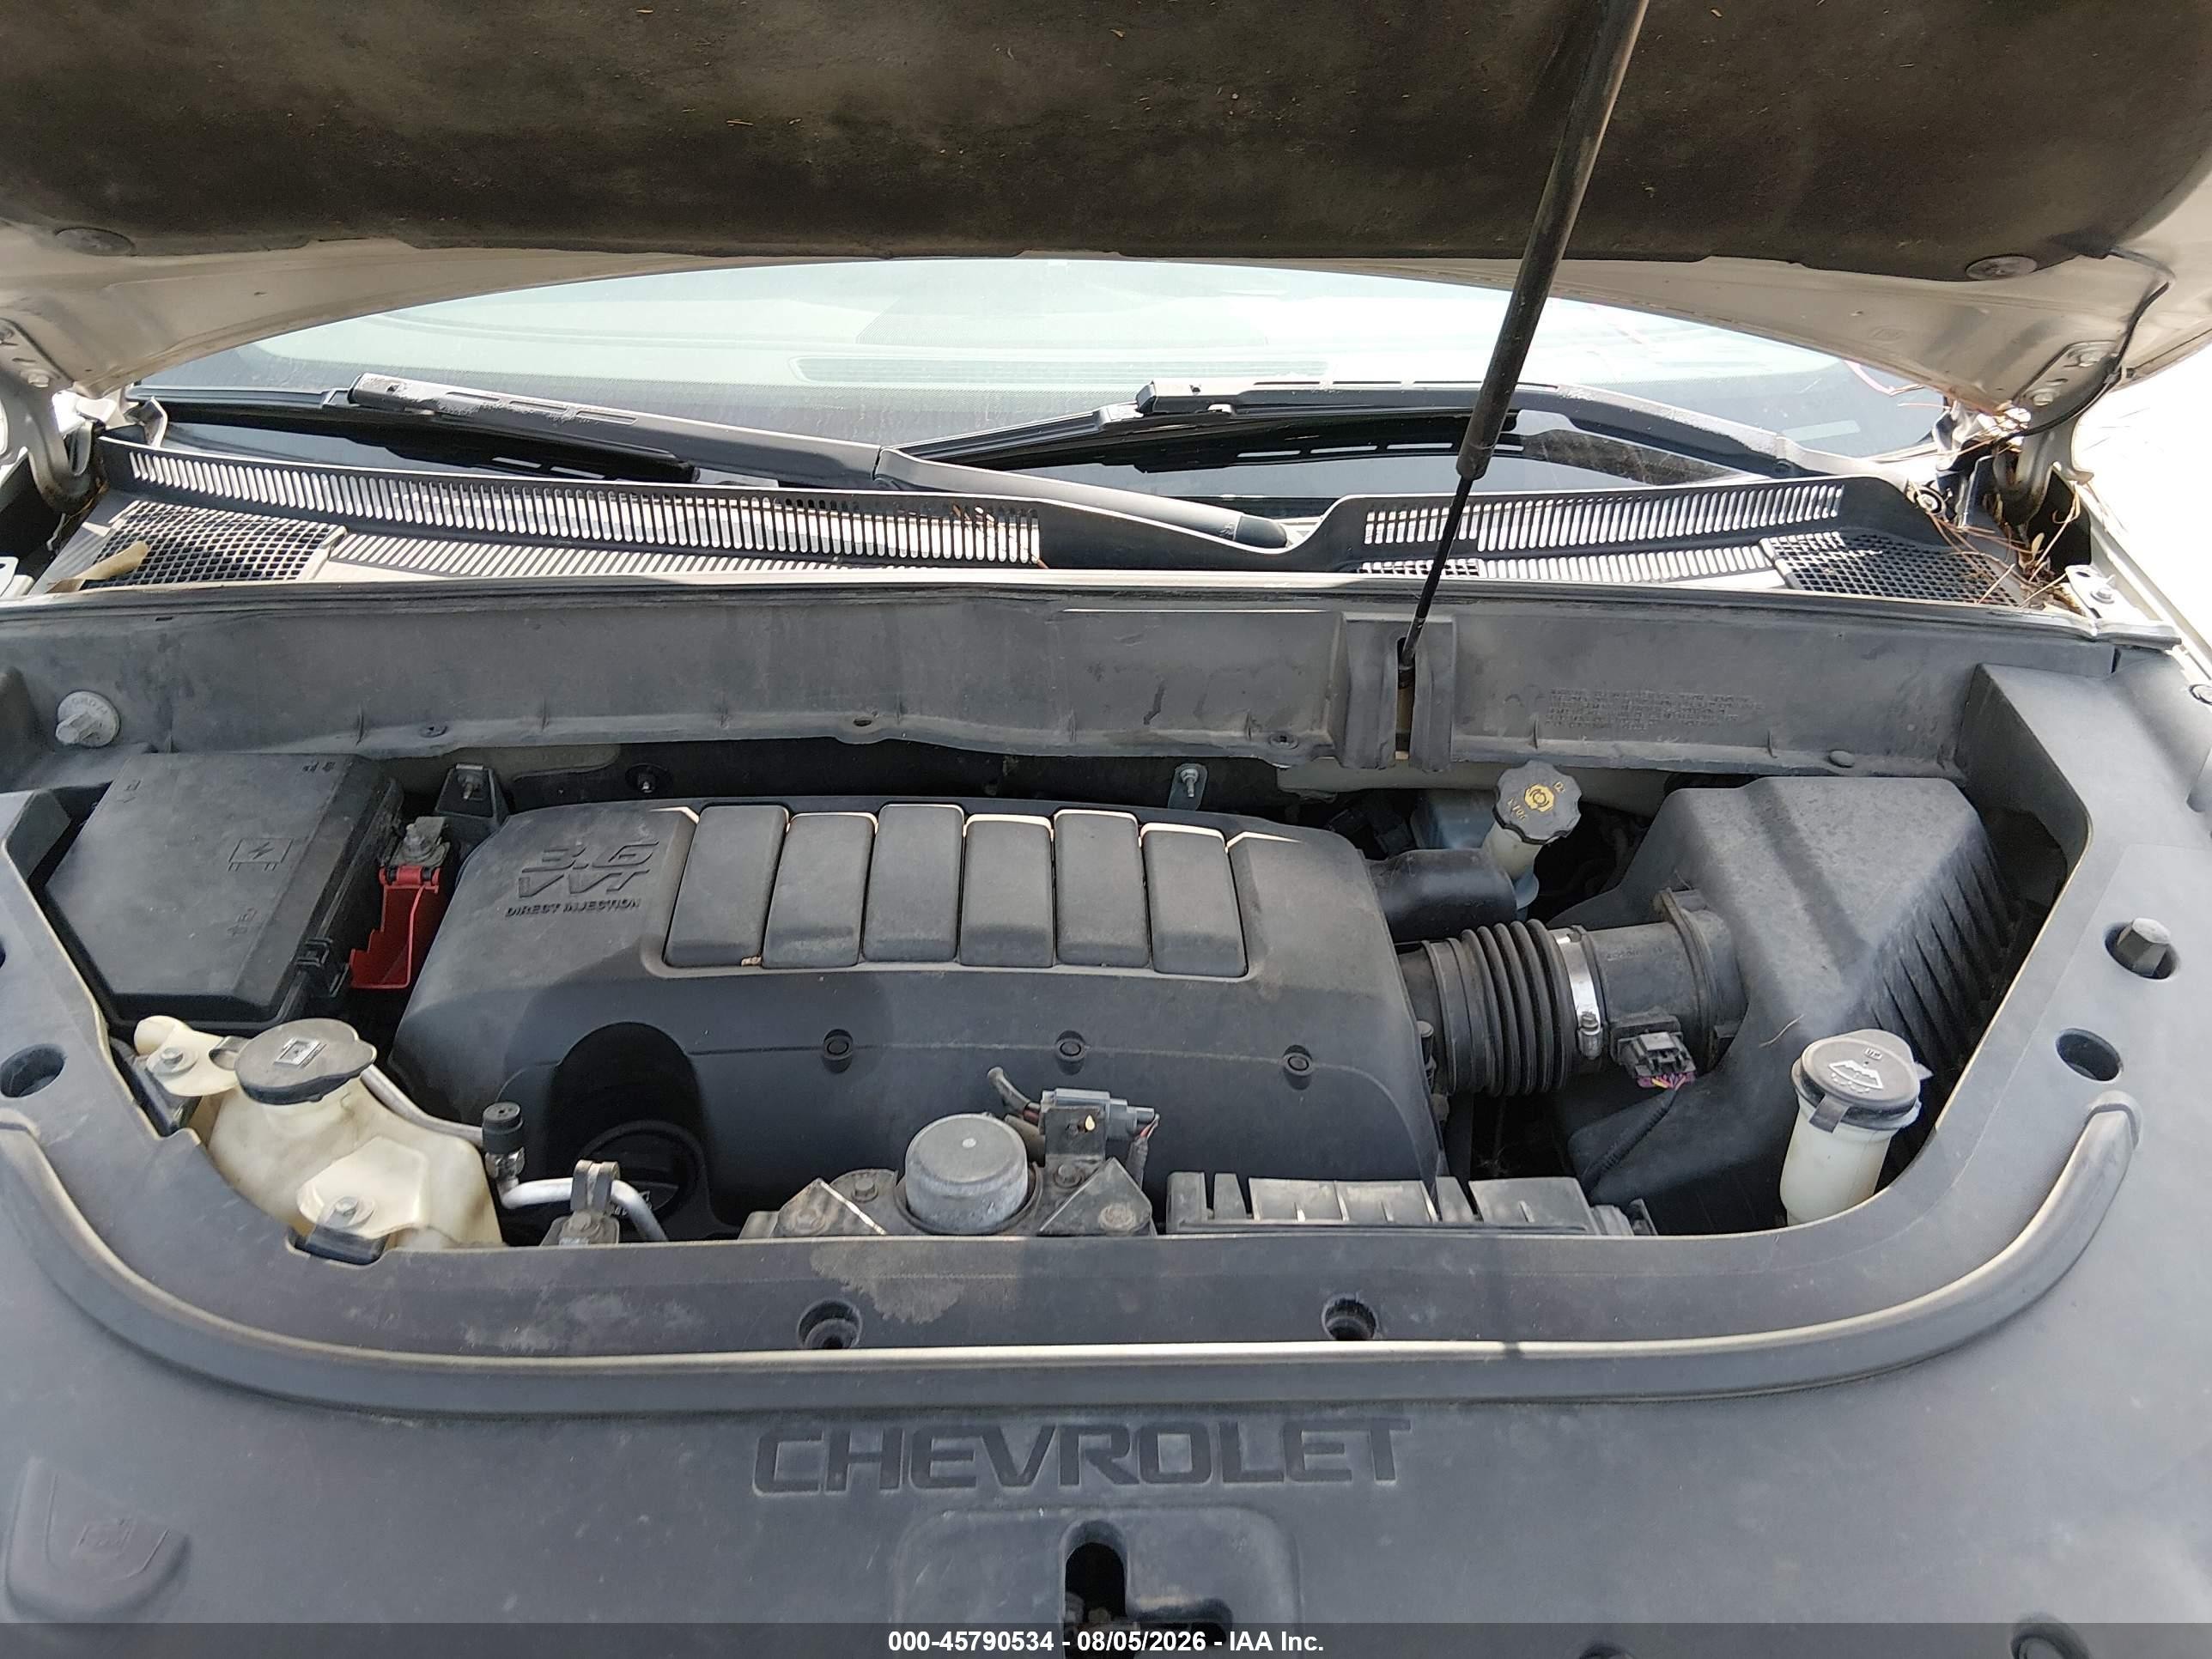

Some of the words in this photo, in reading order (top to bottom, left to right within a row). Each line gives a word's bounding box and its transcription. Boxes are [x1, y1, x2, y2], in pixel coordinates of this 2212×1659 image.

[520, 841, 660, 874] 3.6
[517, 868, 651, 899] VVT
[504, 902, 562, 918] DIRECT
[562, 898, 642, 914] INJECTION
[751, 1419, 1412, 1497] CHEVROLET
